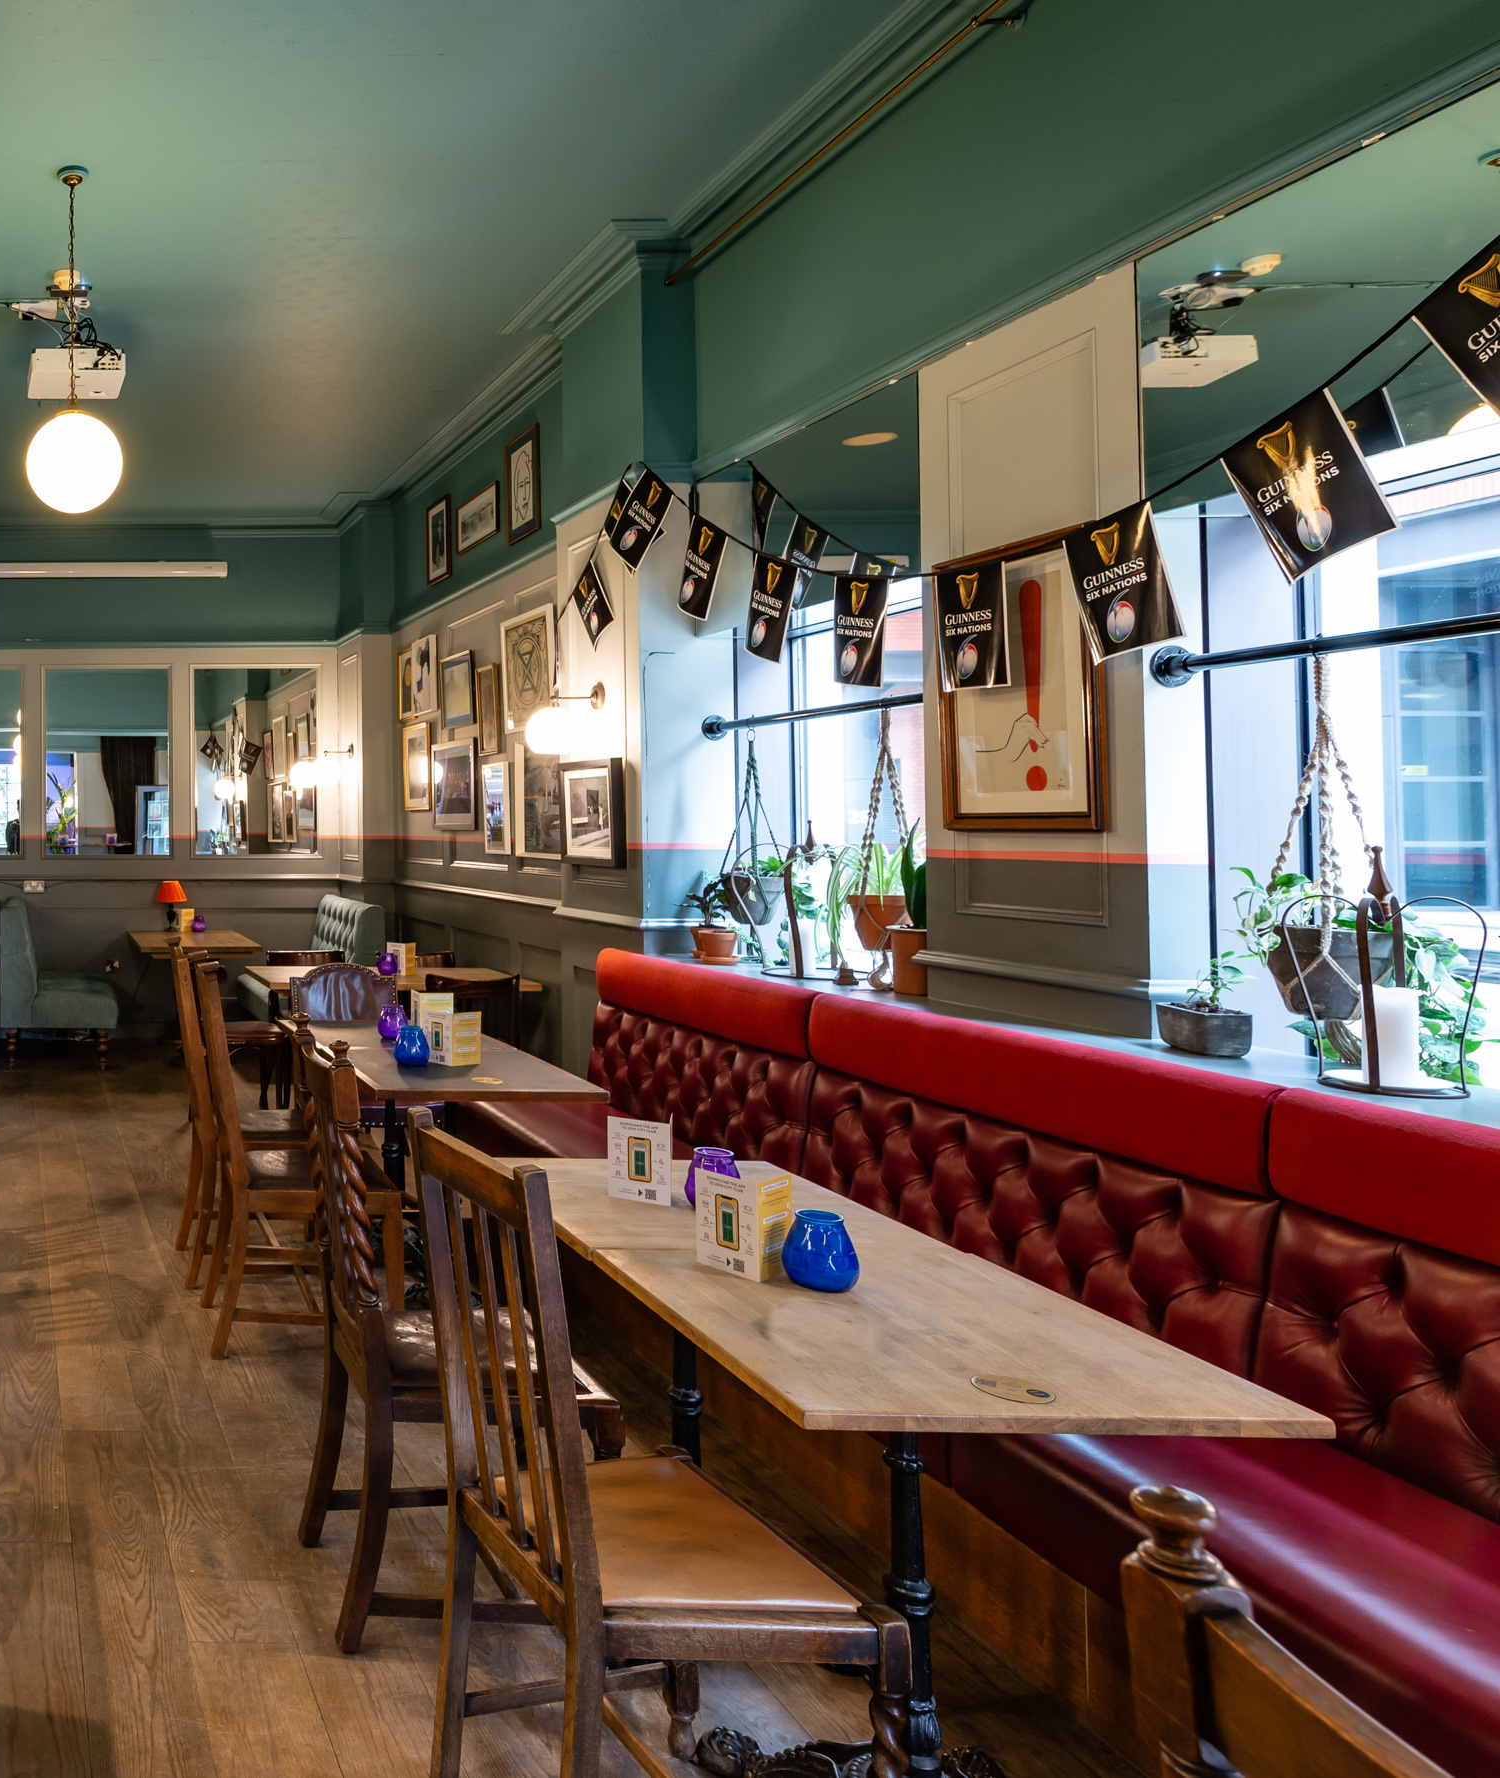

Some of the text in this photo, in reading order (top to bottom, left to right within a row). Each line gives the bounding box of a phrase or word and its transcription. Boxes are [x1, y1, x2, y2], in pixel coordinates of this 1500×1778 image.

[631, 500, 657, 526] GUINNESS
[1263, 499, 1283, 516] SIX
[627, 509, 652, 532] SIX NATIONS
[687, 549, 711, 572] GUINNESS
[689, 563, 708, 580] NATIONS
[1083, 557, 1145, 590] GUINNESS
[1085, 572, 1148, 602] SIX NATIONS
[753, 589, 783, 609] GUINNESS
[758, 604, 780, 618] NATIONS
[945, 609, 992, 626] GUINNESS
[837, 614, 874, 628] GUINNESS
[844, 628, 873, 638] NATIONS
[945, 623, 992, 637] SIX NATIONS
[706, 1175, 730, 1185] DOWNLOAD
